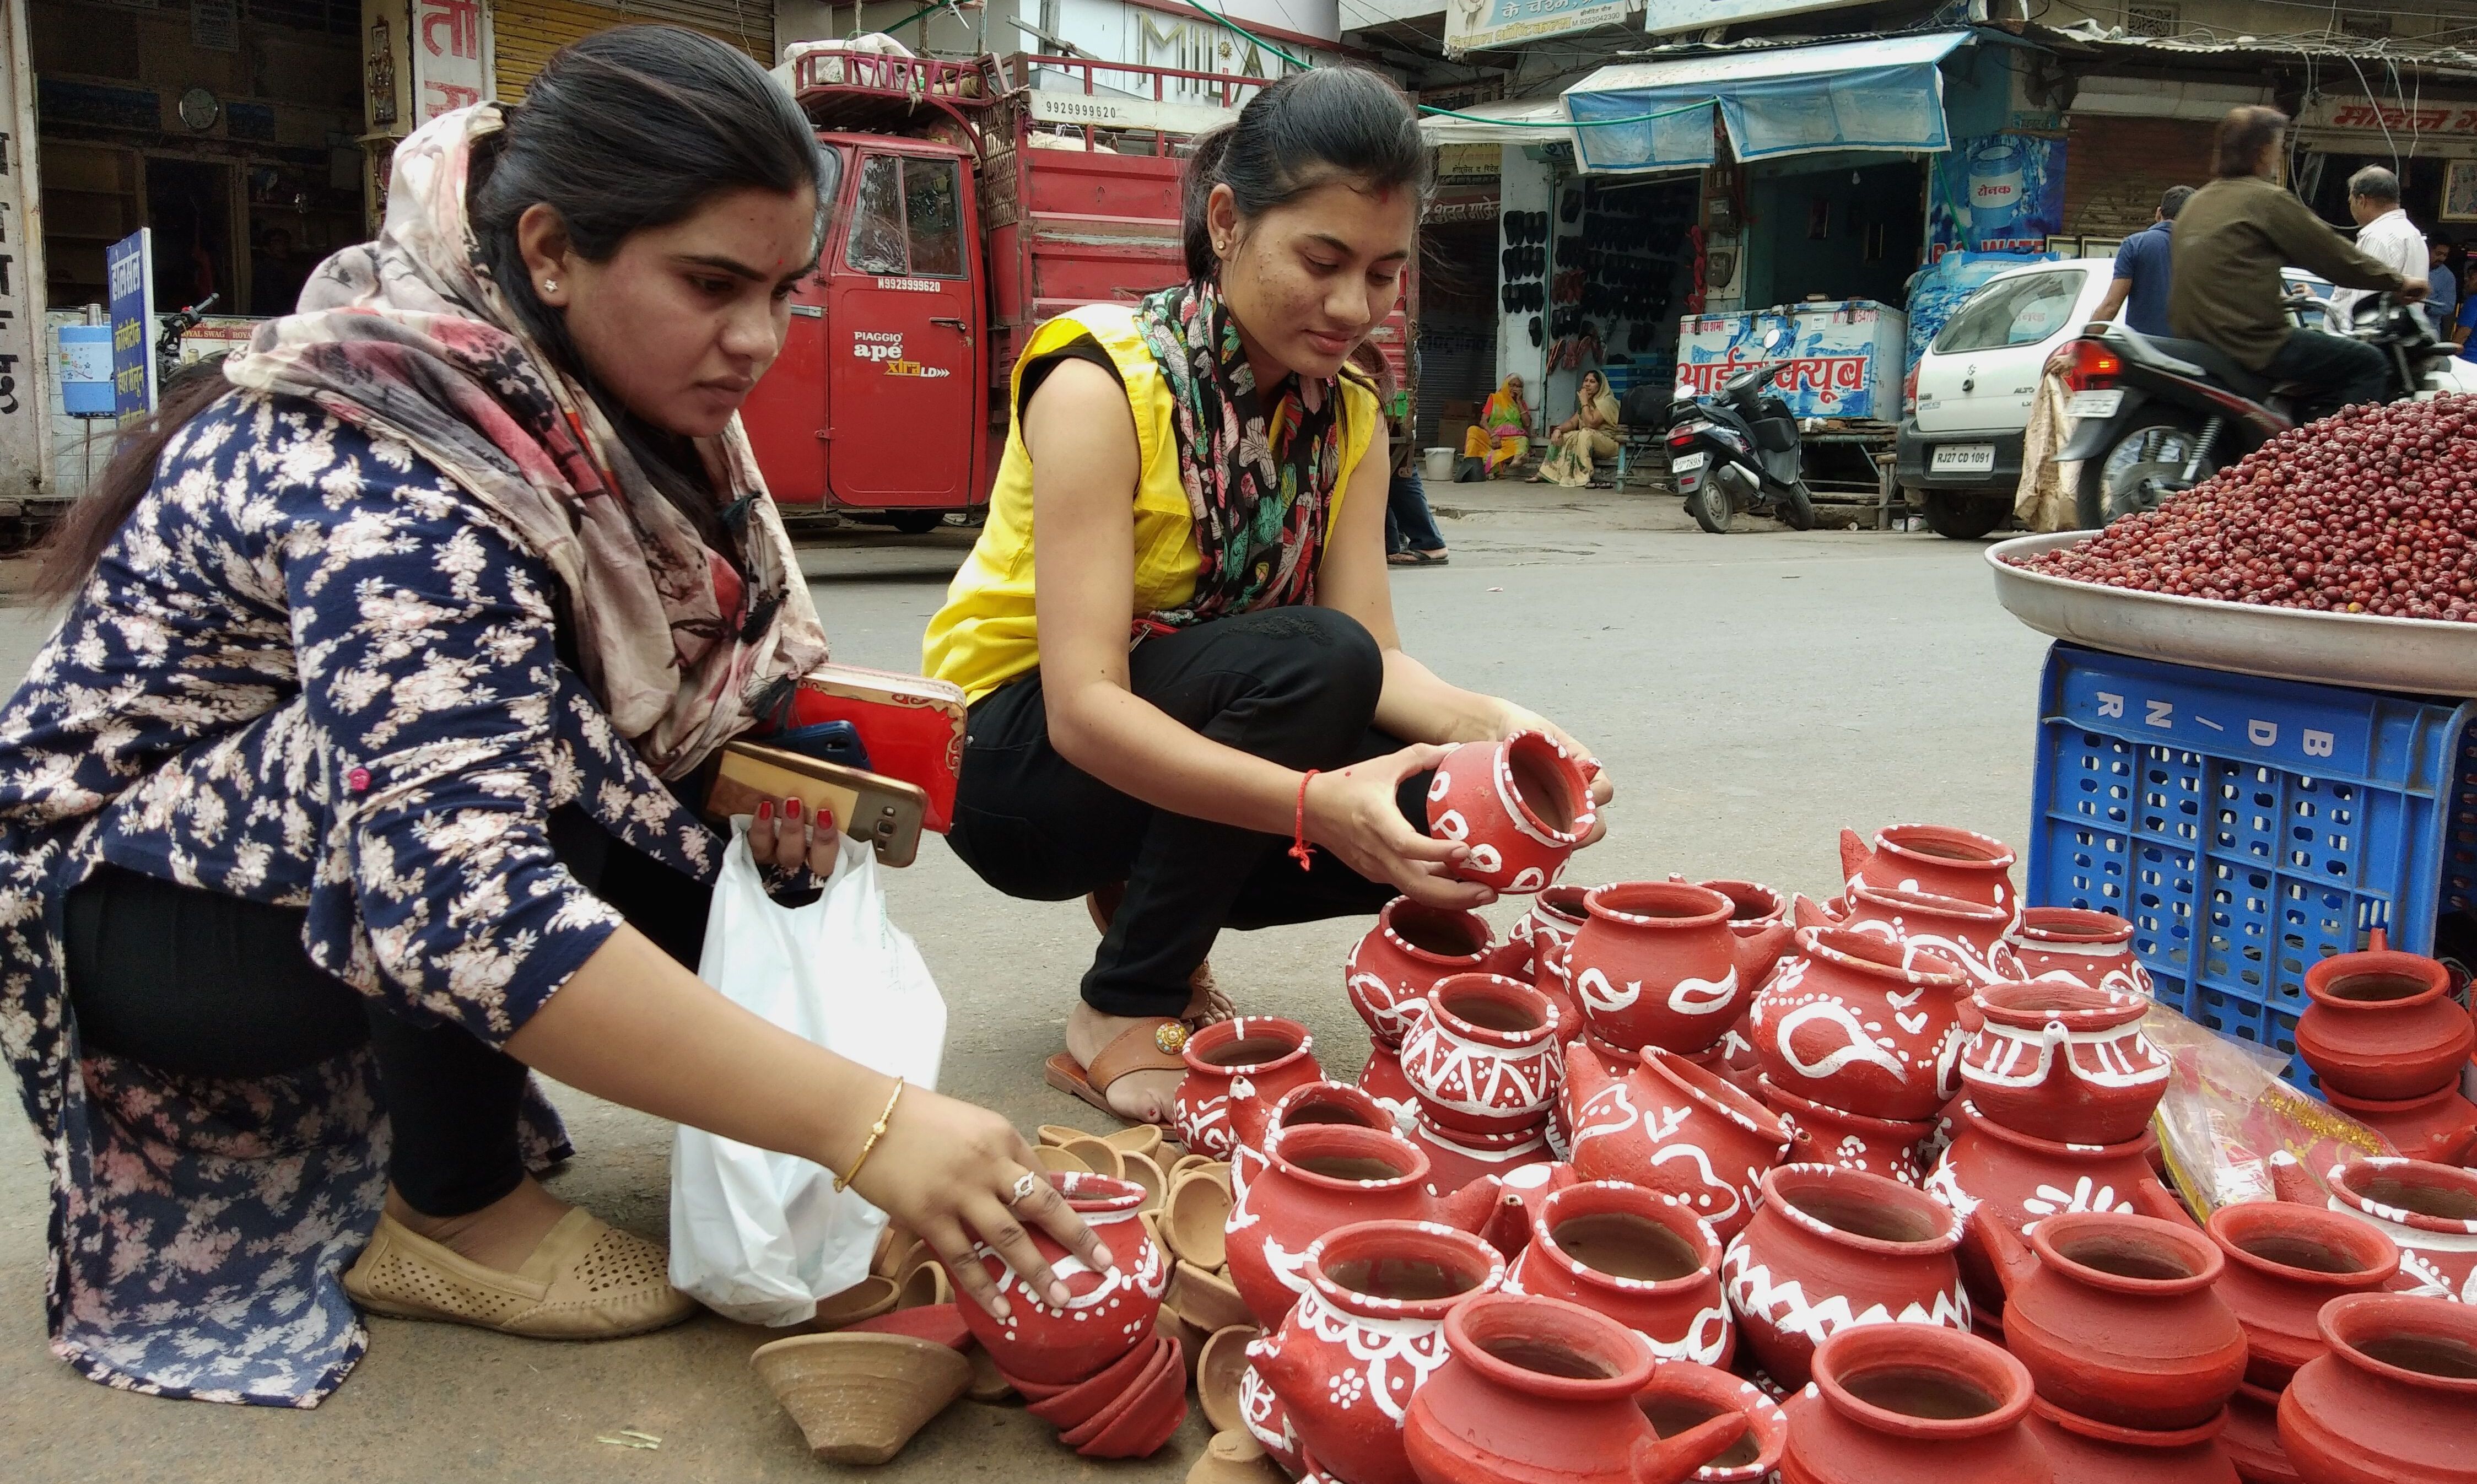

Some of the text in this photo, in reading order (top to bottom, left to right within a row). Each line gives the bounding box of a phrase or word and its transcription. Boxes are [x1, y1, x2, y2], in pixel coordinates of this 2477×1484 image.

[1572, 12, 1620, 27] M.9252042300
[1046, 101, 1116, 118] 9929999620
[1977, 184, 2012, 196] रोनक
[111, 242, 141, 302] होलसेल
[877, 277, 941, 293] M9929999620
[1710, 319, 1724, 332] शर्मा
[854, 331, 902, 342] PIAGGIO
[854, 342, 902, 362] apé
[1937, 452, 1990, 463] RJ27 CD 1091
